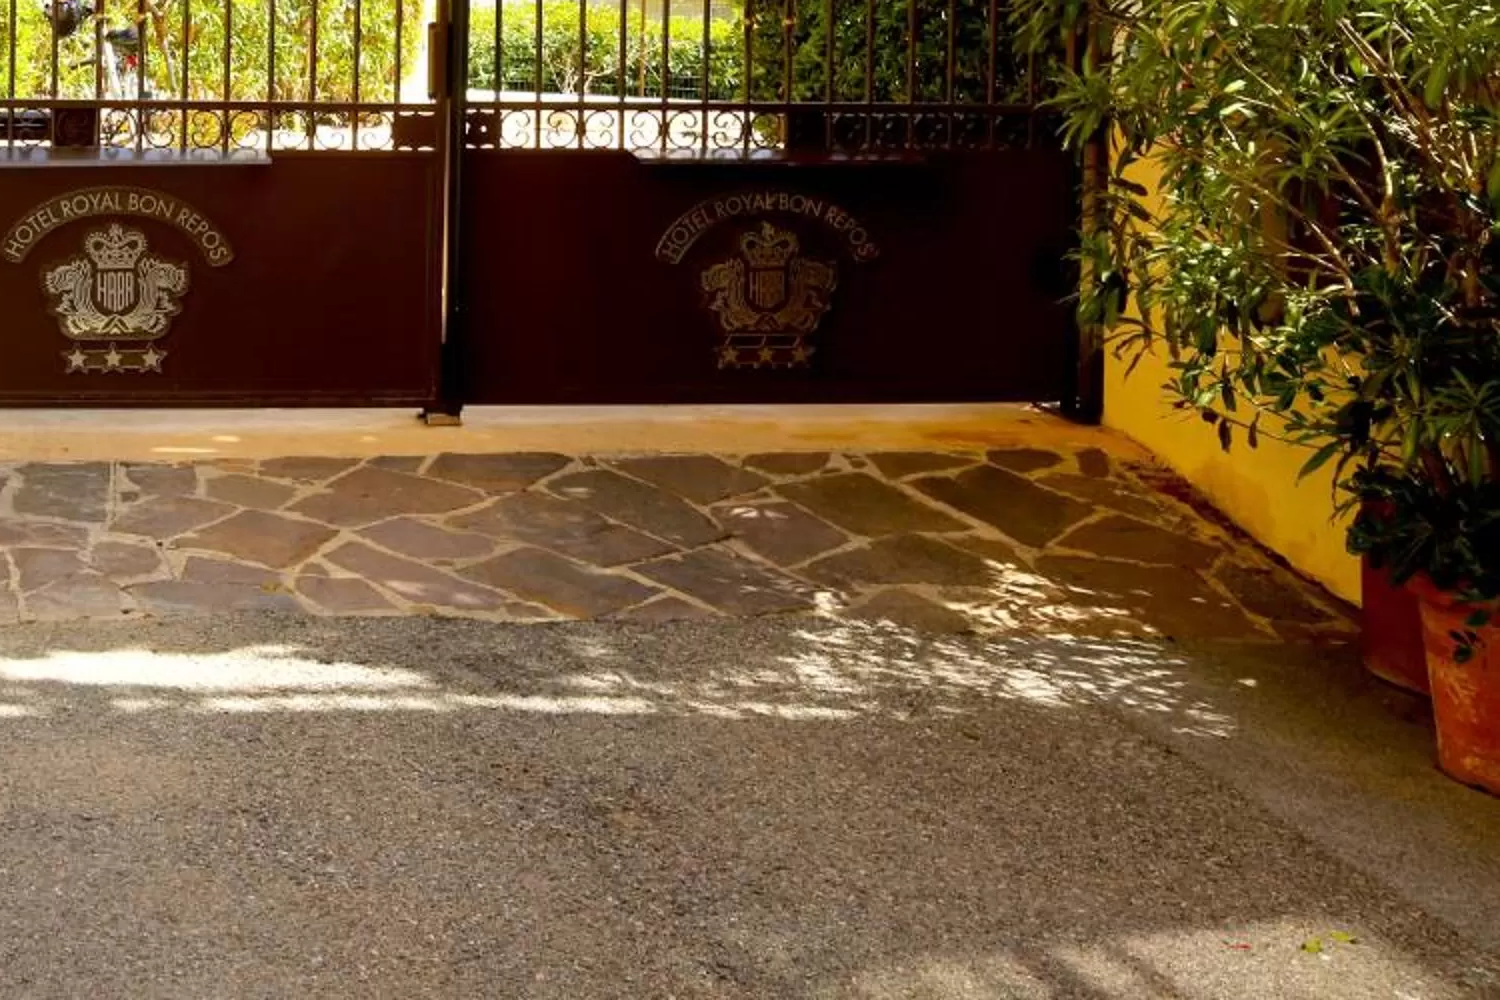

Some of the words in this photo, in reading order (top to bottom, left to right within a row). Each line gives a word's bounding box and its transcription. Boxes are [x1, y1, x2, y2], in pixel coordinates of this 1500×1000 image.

[4, 207, 64, 258] HOTEL
[60, 192, 123, 218] ROYAL
[128, 194, 176, 218] BON
[176, 207, 229, 260] REPOS
[659, 210, 712, 262] HOTEL
[715, 192, 776, 218] ROYAL
[778, 194, 823, 217] BON
[823, 204, 880, 263] REPOS
